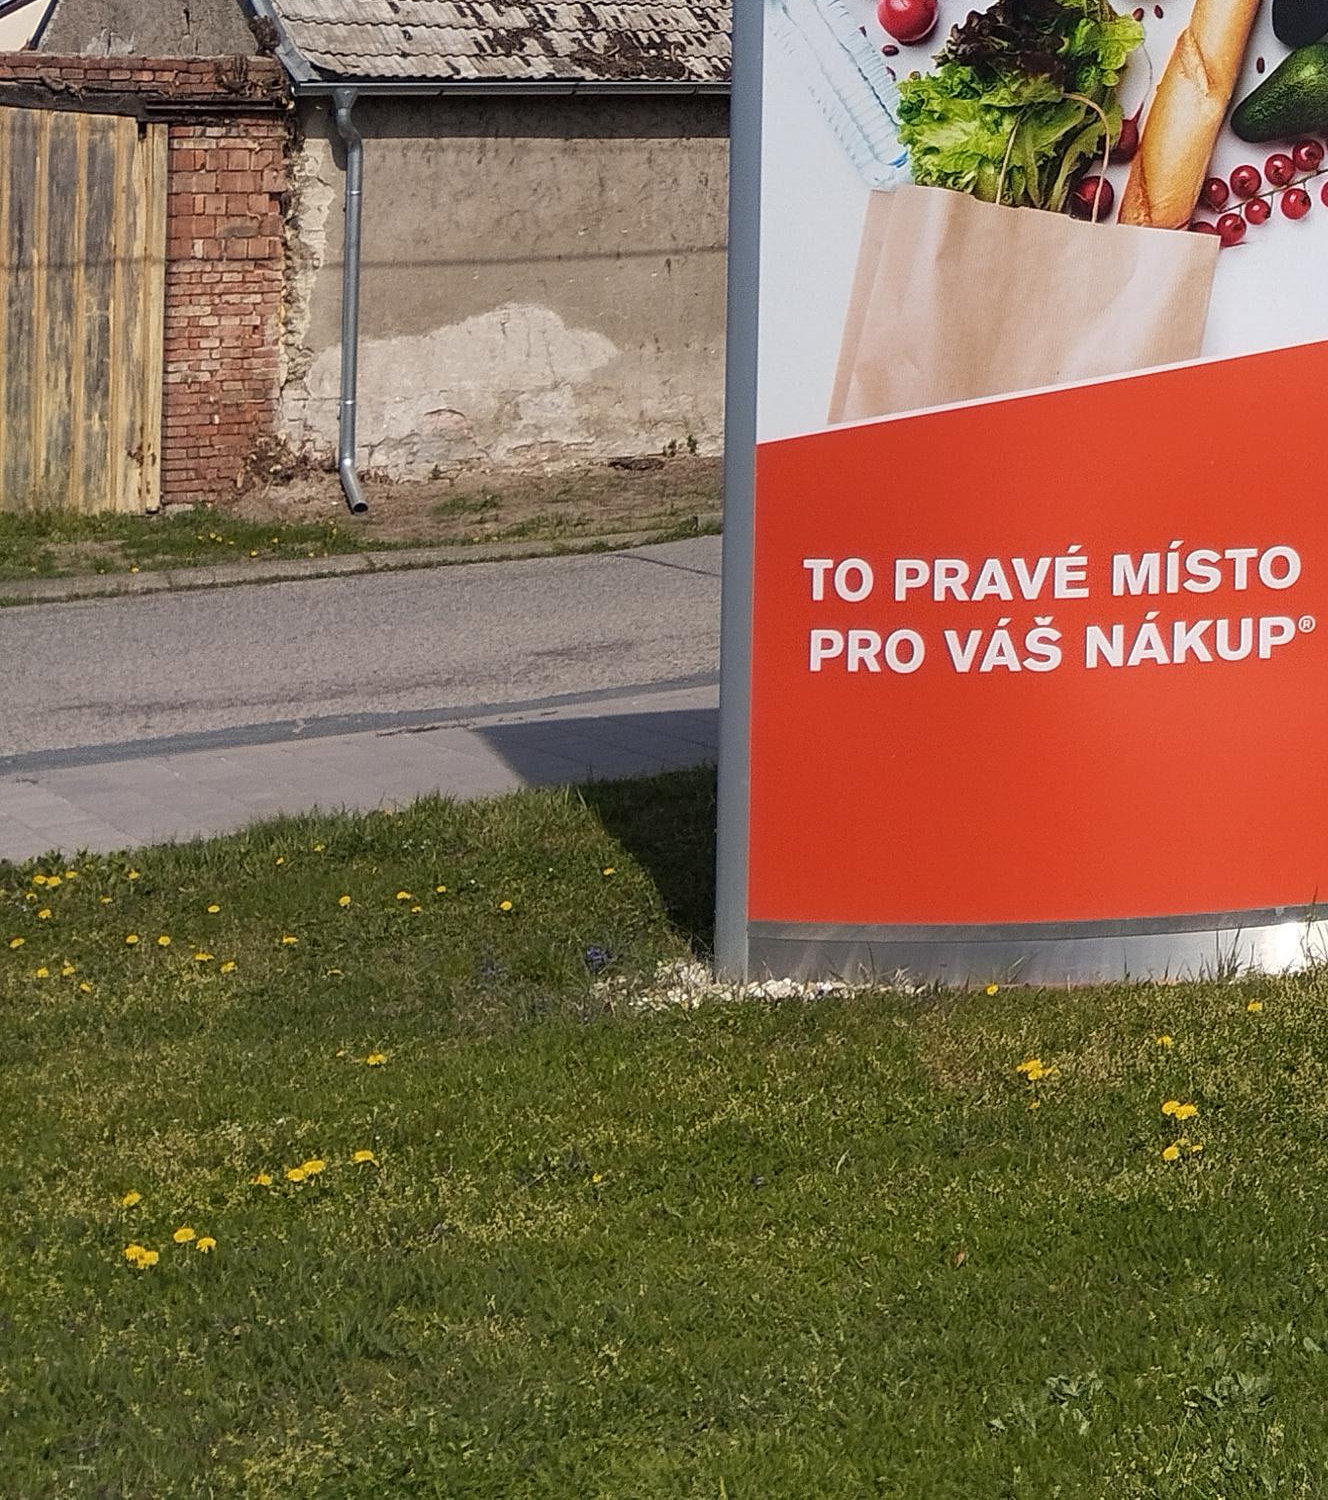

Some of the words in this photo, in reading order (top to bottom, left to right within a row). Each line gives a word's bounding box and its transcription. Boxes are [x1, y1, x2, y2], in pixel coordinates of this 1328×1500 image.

[803, 557, 874, 602] TO
[894, 544, 1090, 602] PRAVÉ
[1112, 540, 1302, 597] MÍSTO
[809, 628, 926, 673] PRO
[943, 615, 1063, 673] VÁŠ
